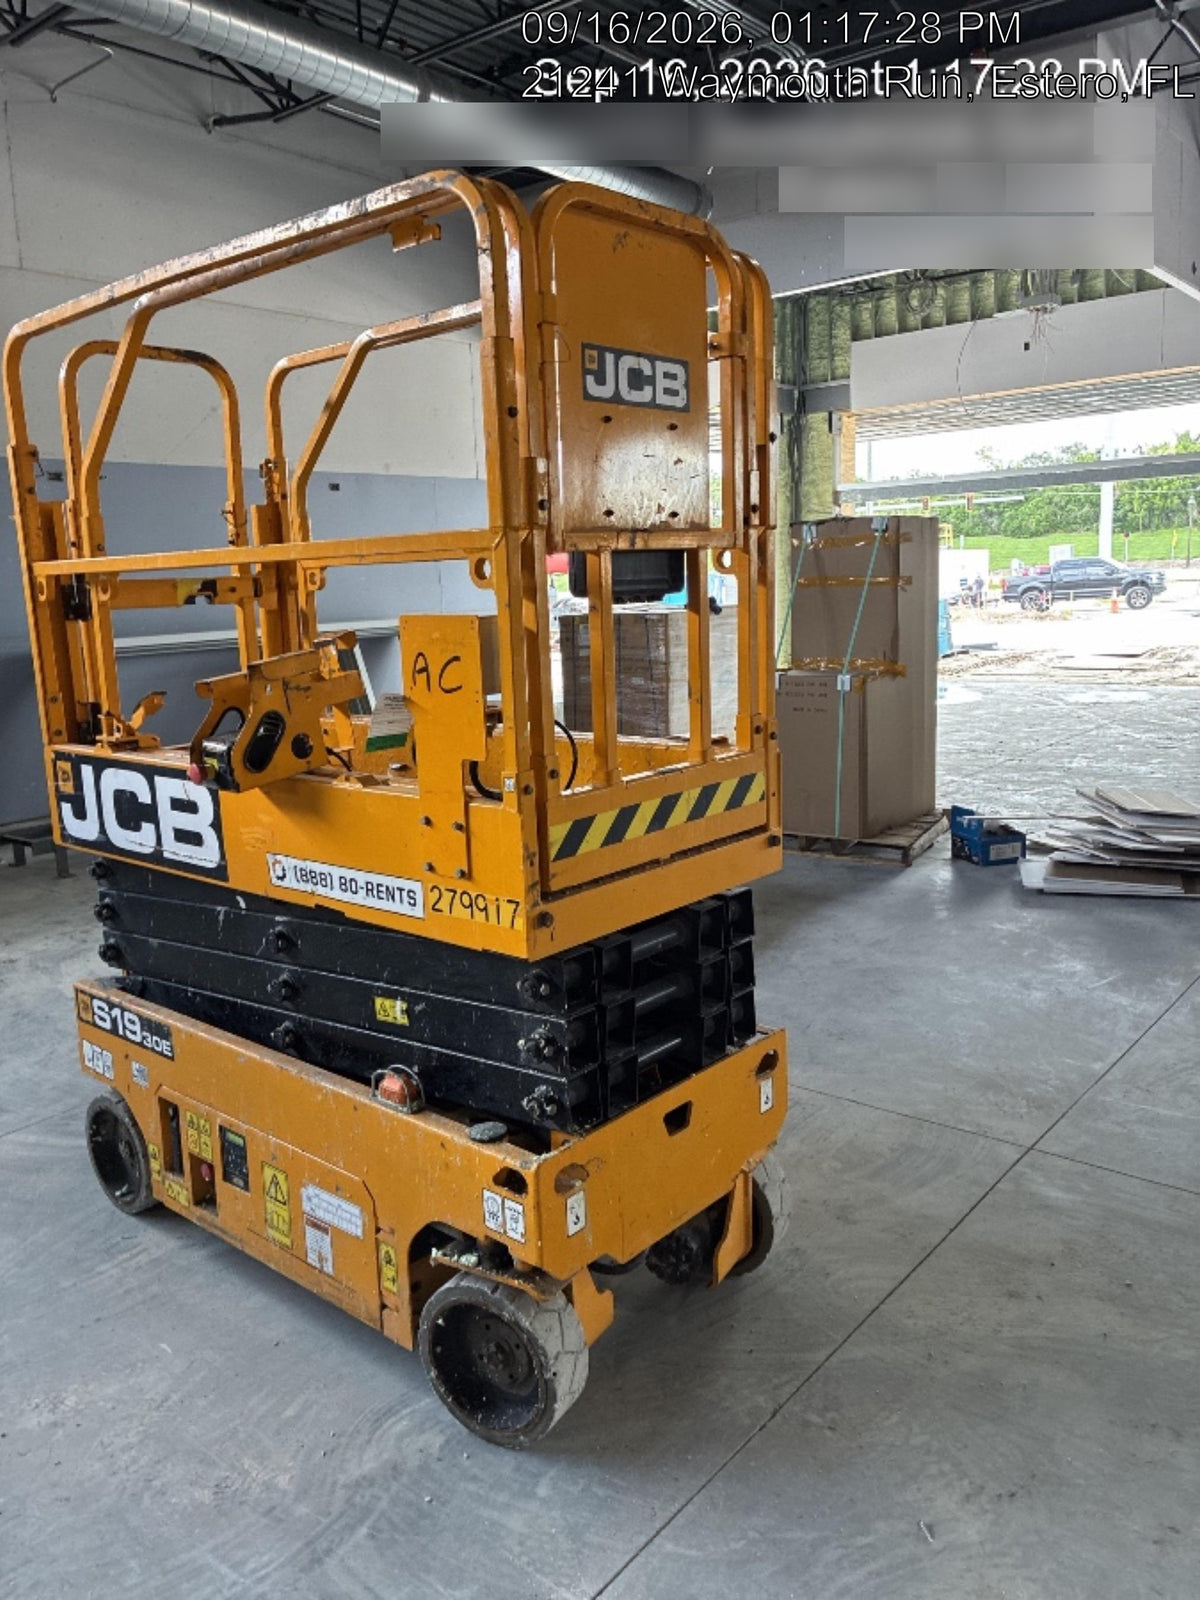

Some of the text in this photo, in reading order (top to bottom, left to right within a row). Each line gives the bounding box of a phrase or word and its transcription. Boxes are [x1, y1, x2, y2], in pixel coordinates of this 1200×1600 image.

[586, 351, 687, 408] JCB
[412, 651, 463, 694] AC
[60, 763, 221, 869] JCB
[293, 864, 418, 907] (888) 80-RENTS
[429, 884, 521, 929] 279917
